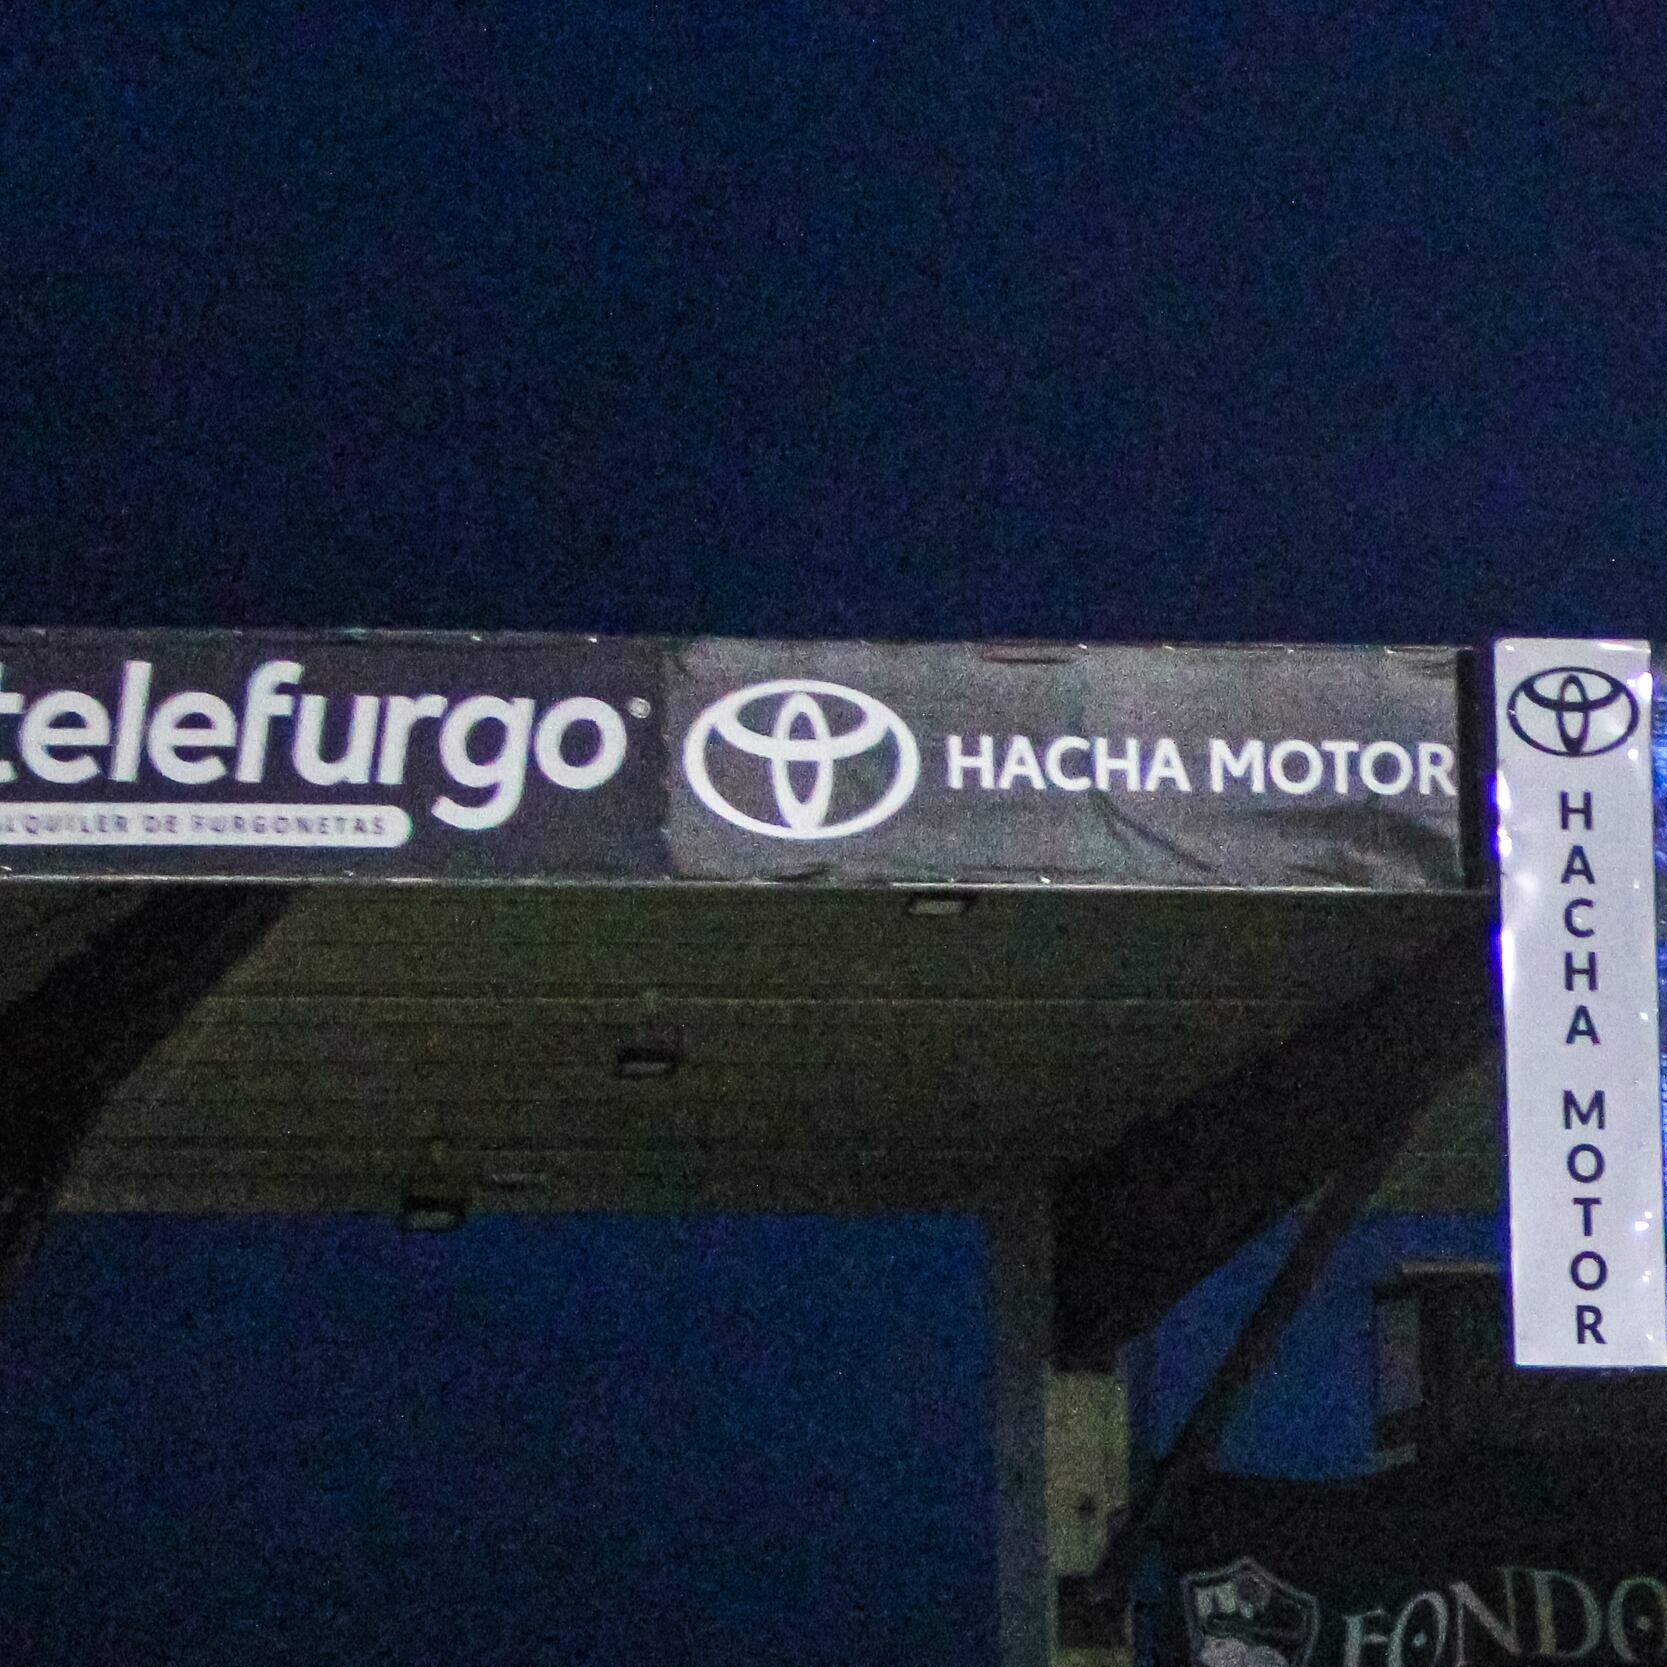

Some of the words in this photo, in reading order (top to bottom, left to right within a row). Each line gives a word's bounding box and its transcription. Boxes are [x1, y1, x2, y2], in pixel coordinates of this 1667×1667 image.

[946, 735, 1192, 793] HACHA
[1210, 739, 1458, 796] MOTOR
[1558, 790, 1601, 1047] HACHA
[1563, 1089, 1608, 1345] MOTOR
